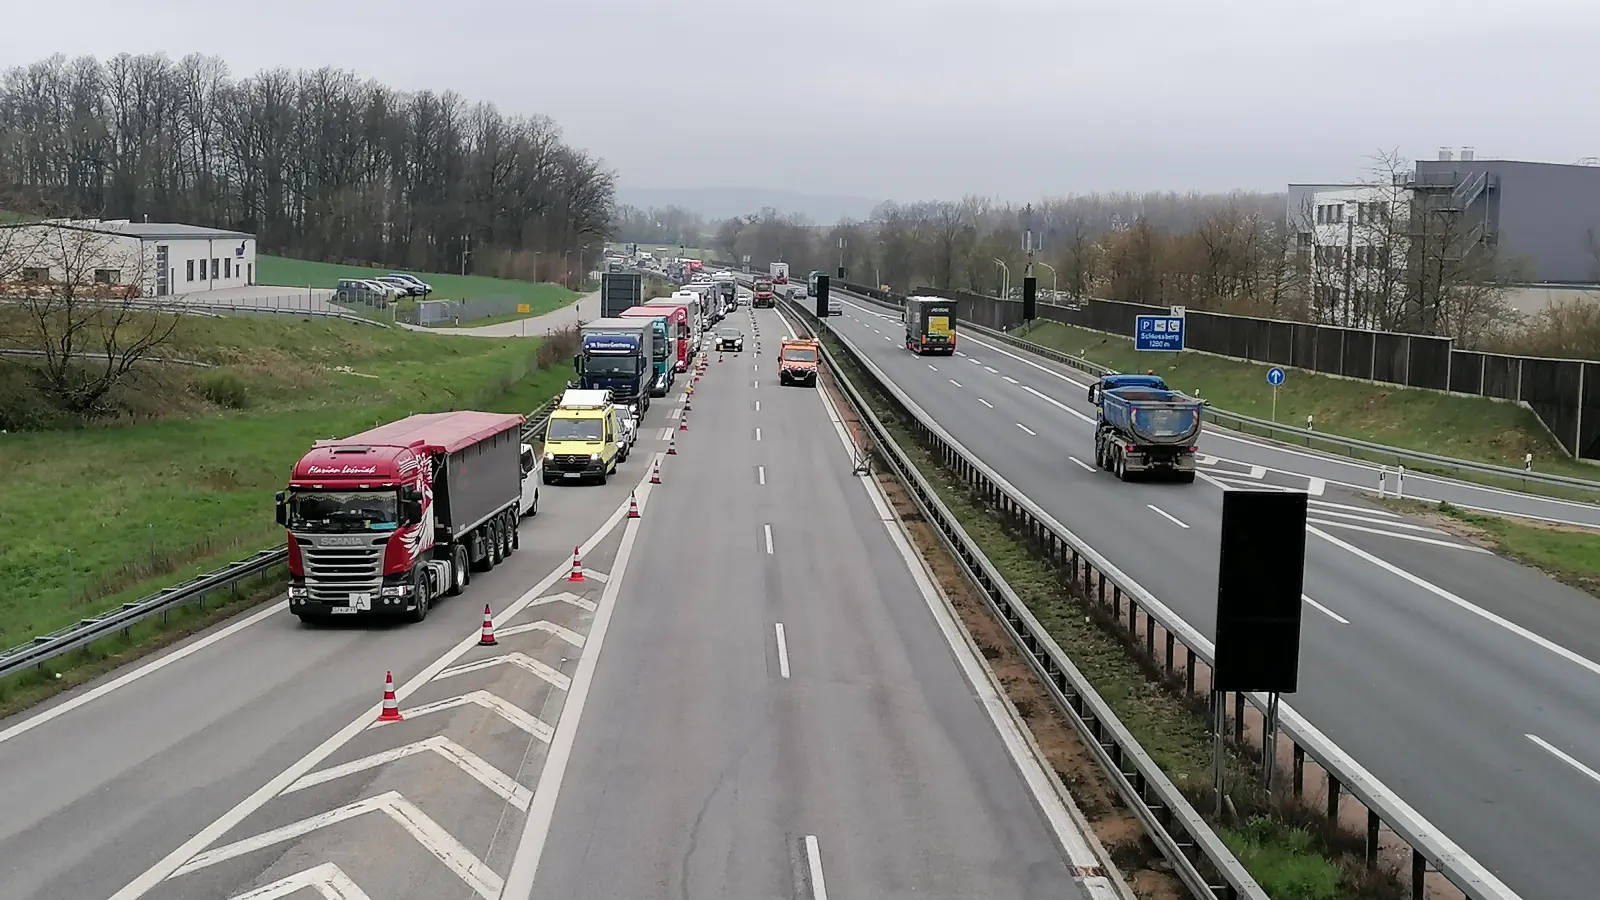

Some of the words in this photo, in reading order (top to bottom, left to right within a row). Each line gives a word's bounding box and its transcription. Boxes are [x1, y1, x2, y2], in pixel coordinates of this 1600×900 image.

[1143, 321, 1150, 330] P
[320, 537, 364, 546] SCANIA
[355, 595, 366, 609] A
